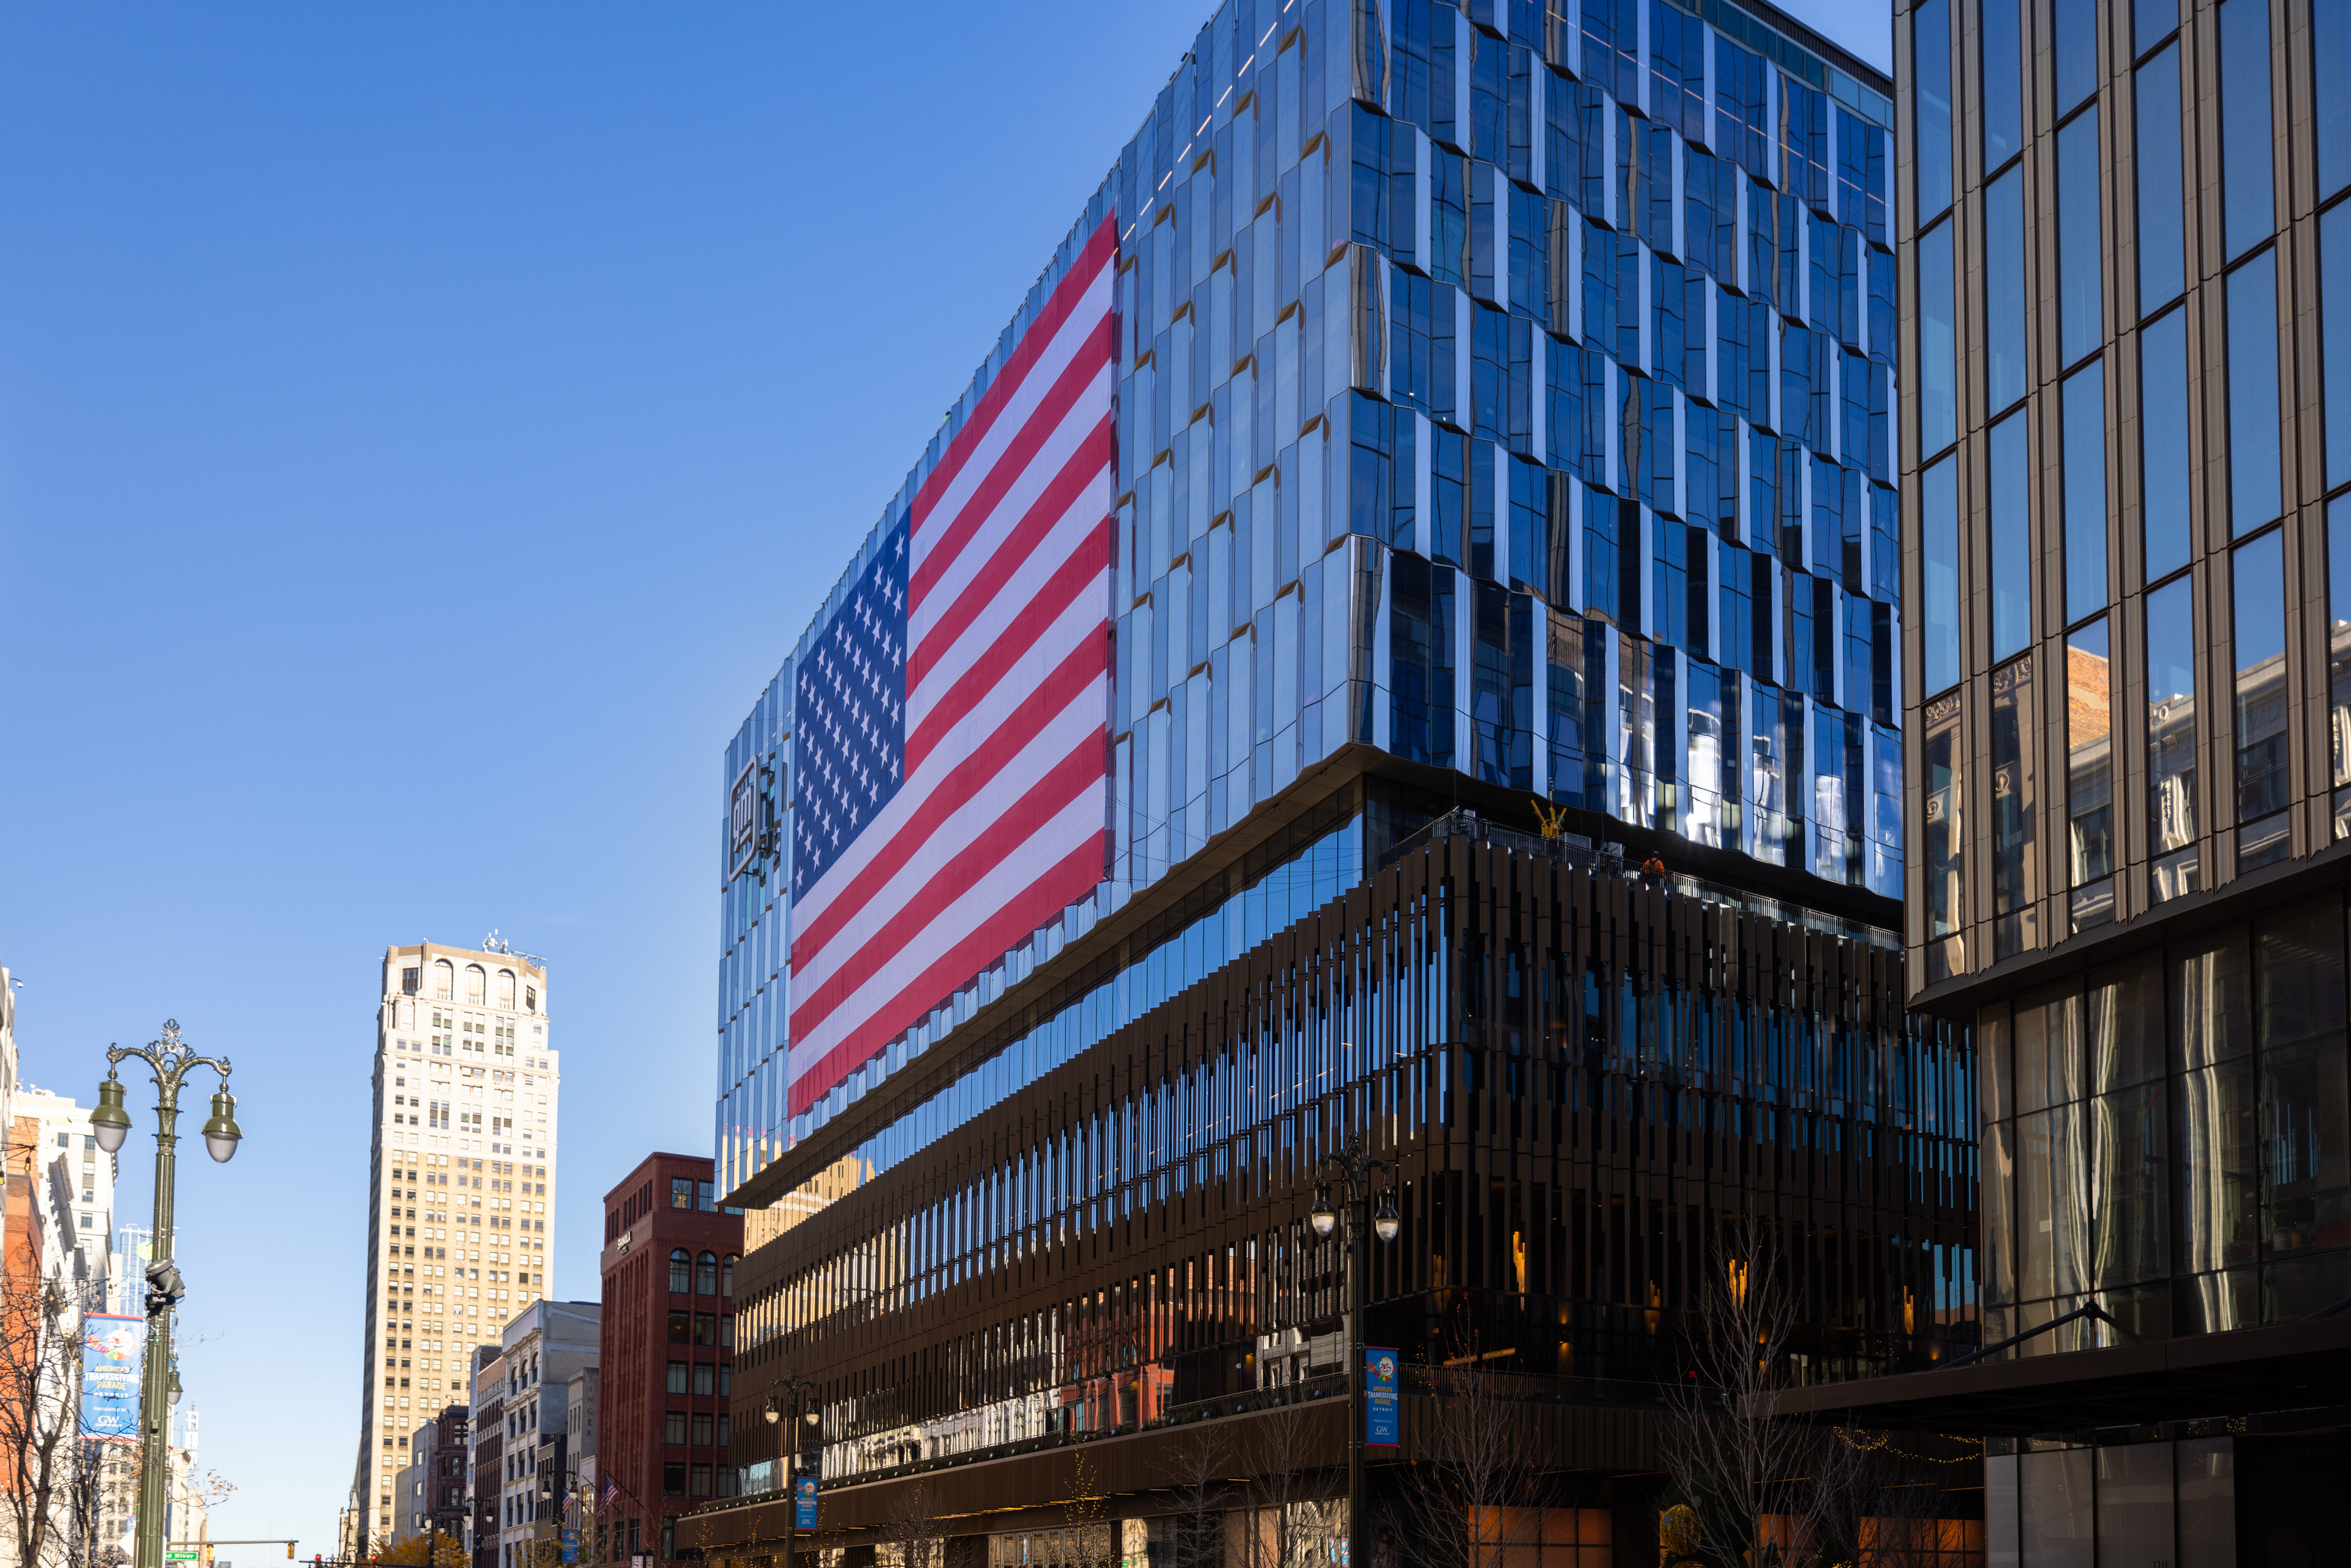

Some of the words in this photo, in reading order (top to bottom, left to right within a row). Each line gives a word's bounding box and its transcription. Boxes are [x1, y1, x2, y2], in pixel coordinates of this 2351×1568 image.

[84, 1372, 140, 1384] THANKSGIVING
[97, 1381, 126, 1390] PARADE
[1367, 1391, 1398, 1400] THANKSGIVING
[98, 1416, 119, 1424] GW
